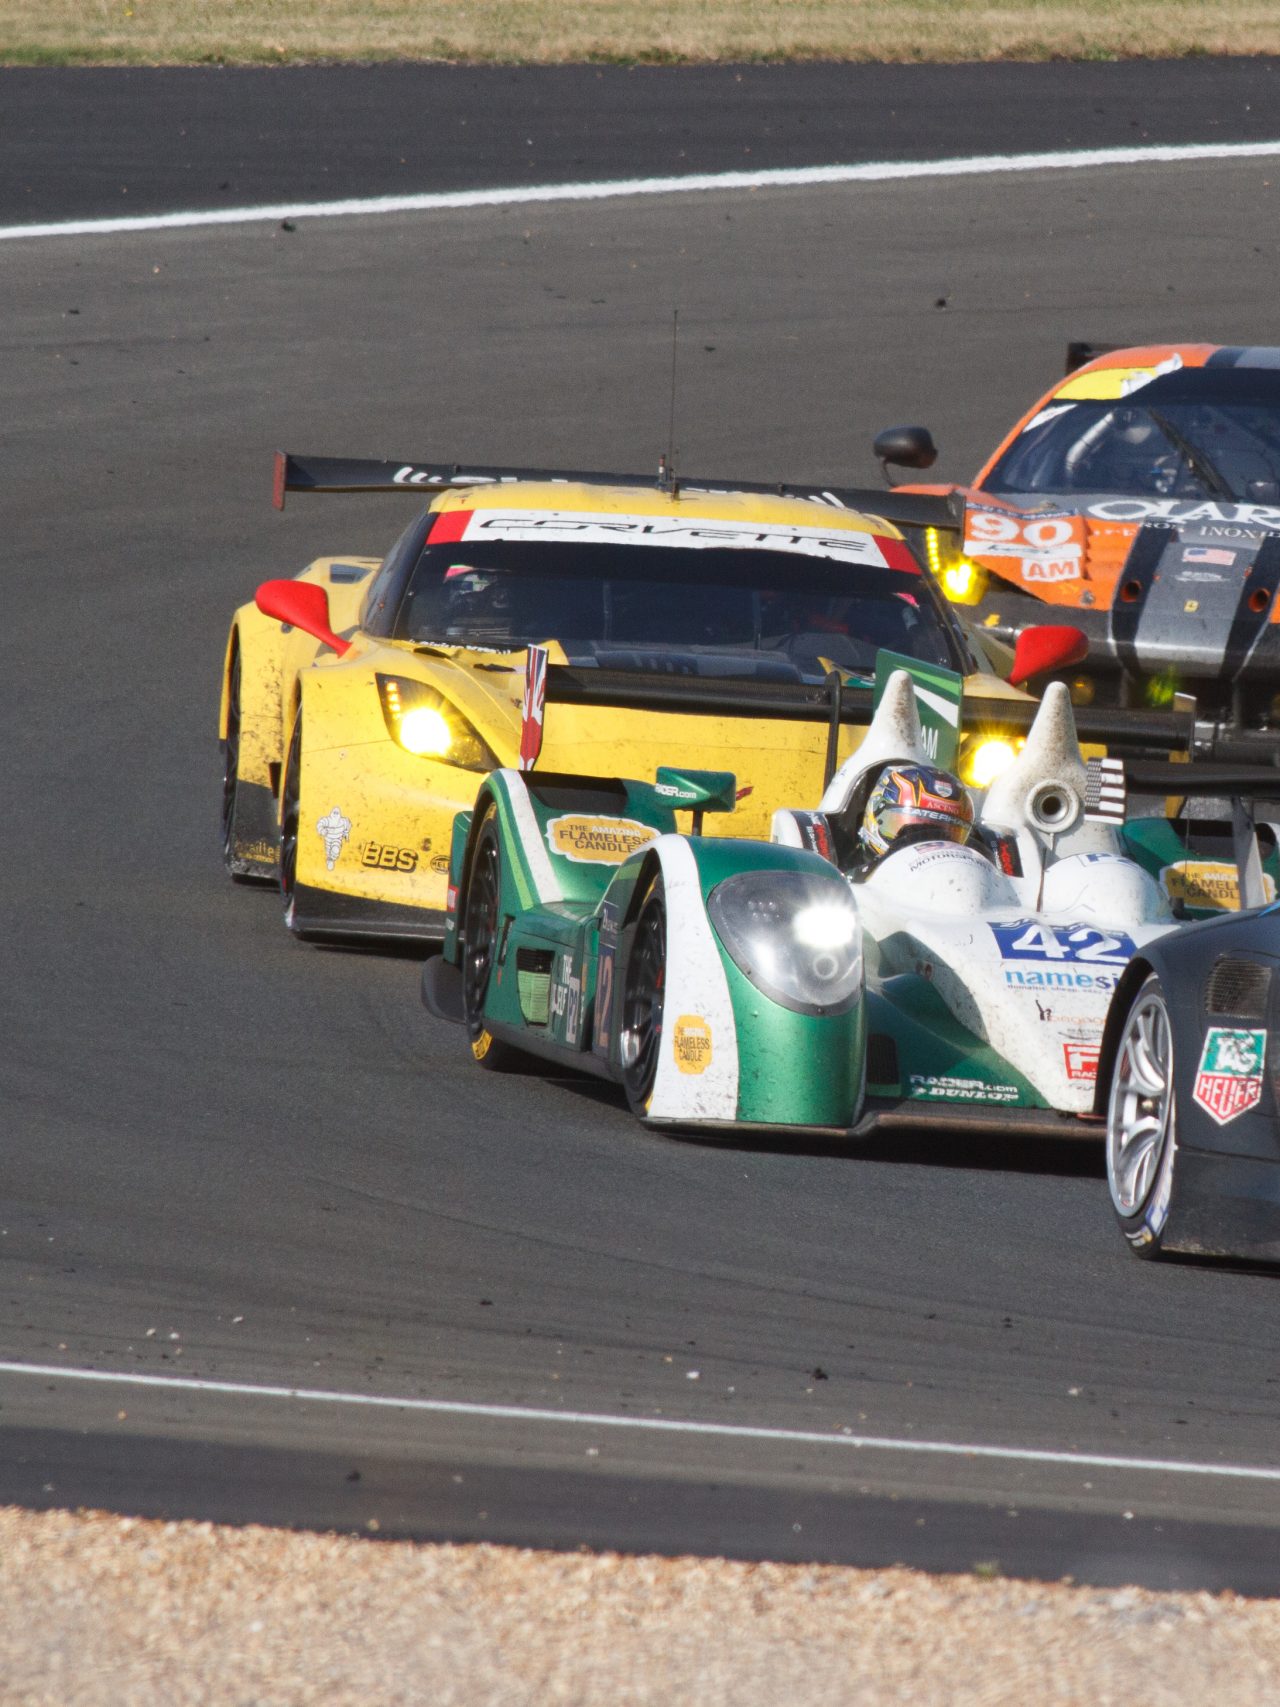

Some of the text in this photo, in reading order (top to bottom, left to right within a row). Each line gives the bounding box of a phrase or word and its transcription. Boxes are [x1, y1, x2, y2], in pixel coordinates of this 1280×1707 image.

[479, 518, 868, 552] CORVETTE
[970, 513, 1073, 548] 90
[1028, 561, 1075, 579] AM
[568, 824, 593, 832] THE
[361, 842, 419, 874] BBS
[1186, 887, 1238, 899] CANDL
[1012, 925, 1131, 962] 42
[1005, 970, 1120, 989] namesi
[928, 1086, 1019, 1101] DUNLOP
[1198, 1077, 1258, 1115] HEUER
